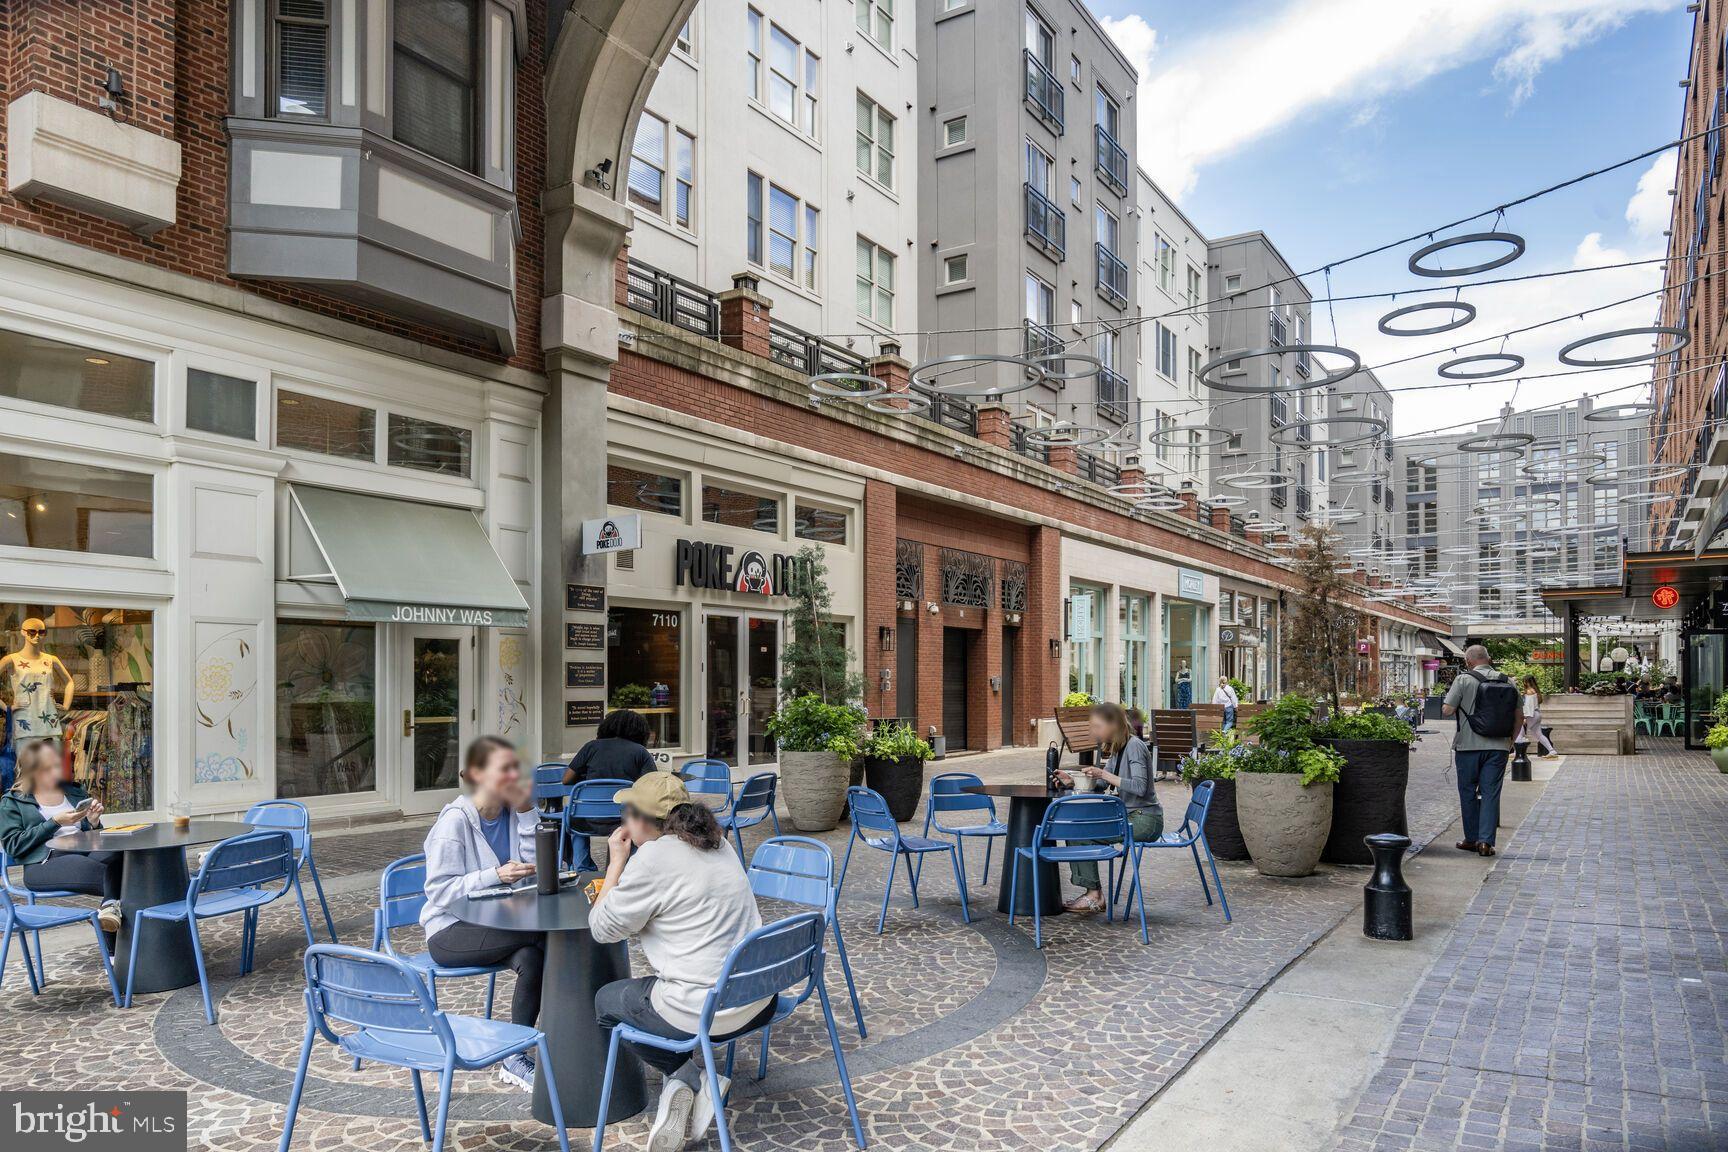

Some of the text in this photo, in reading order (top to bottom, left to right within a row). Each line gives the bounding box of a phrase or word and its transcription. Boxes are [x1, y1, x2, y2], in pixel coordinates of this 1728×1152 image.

[676, 539, 734, 591] POKE
[392, 606, 493, 625] JOHNNY WAS
[652, 613, 678, 627] 7110
